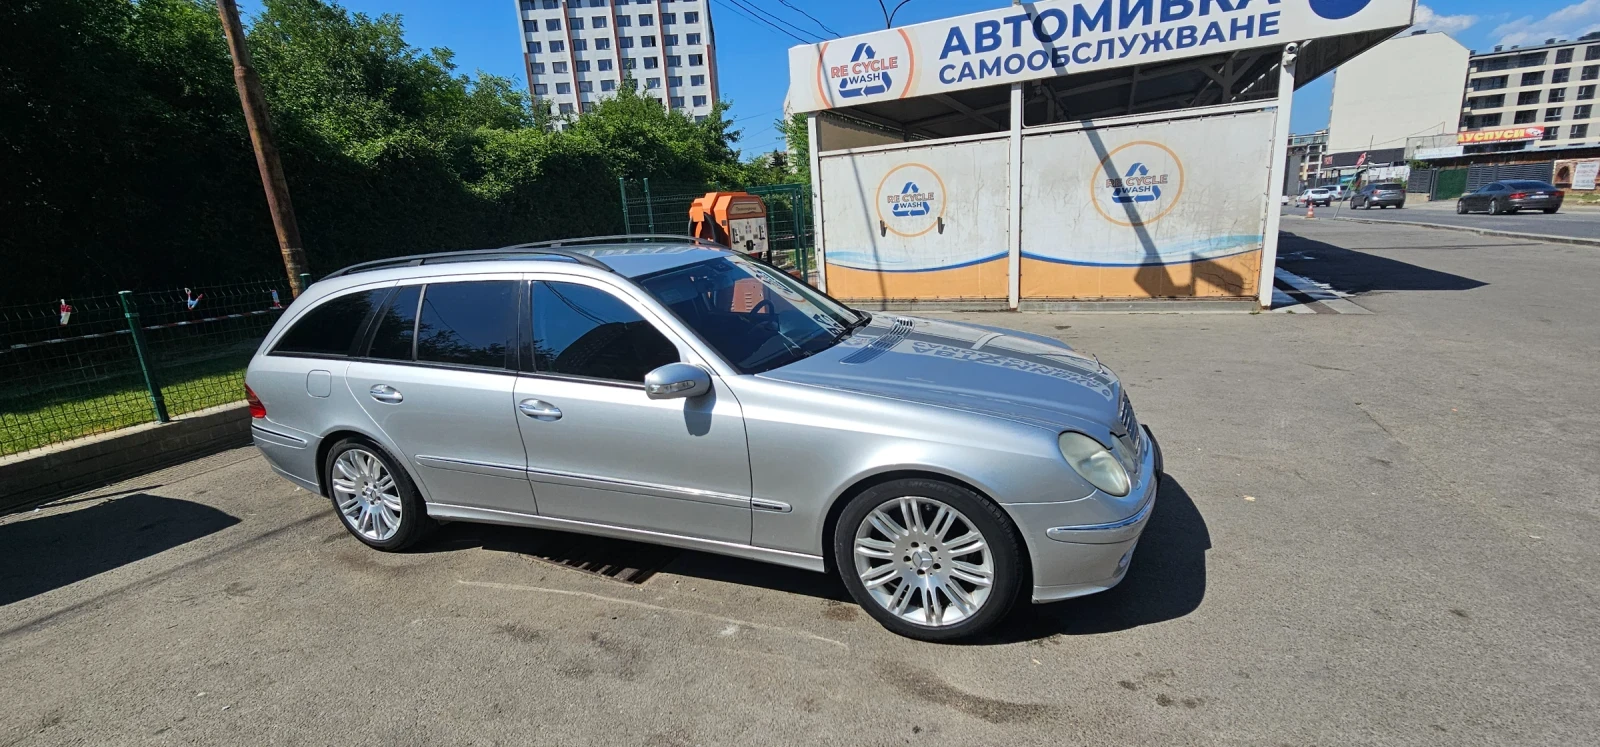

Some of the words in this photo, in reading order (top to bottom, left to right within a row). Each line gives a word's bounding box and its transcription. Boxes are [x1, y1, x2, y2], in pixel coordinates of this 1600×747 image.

[939, 0, 1281, 60] АВТОМИВ
[939, 11, 1281, 84] САМООБСЛУЖВАНЕ
[830, 65, 849, 78] RE
[852, 56, 898, 74] CYCLE
[849, 72, 880, 84] WASH
[1106, 178, 1122, 188] RE
[1126, 174, 1168, 186] CYCLE
[1122, 186, 1151, 194] WASH
[887, 195, 900, 203] RE
[902, 192, 934, 202] CYCLE
